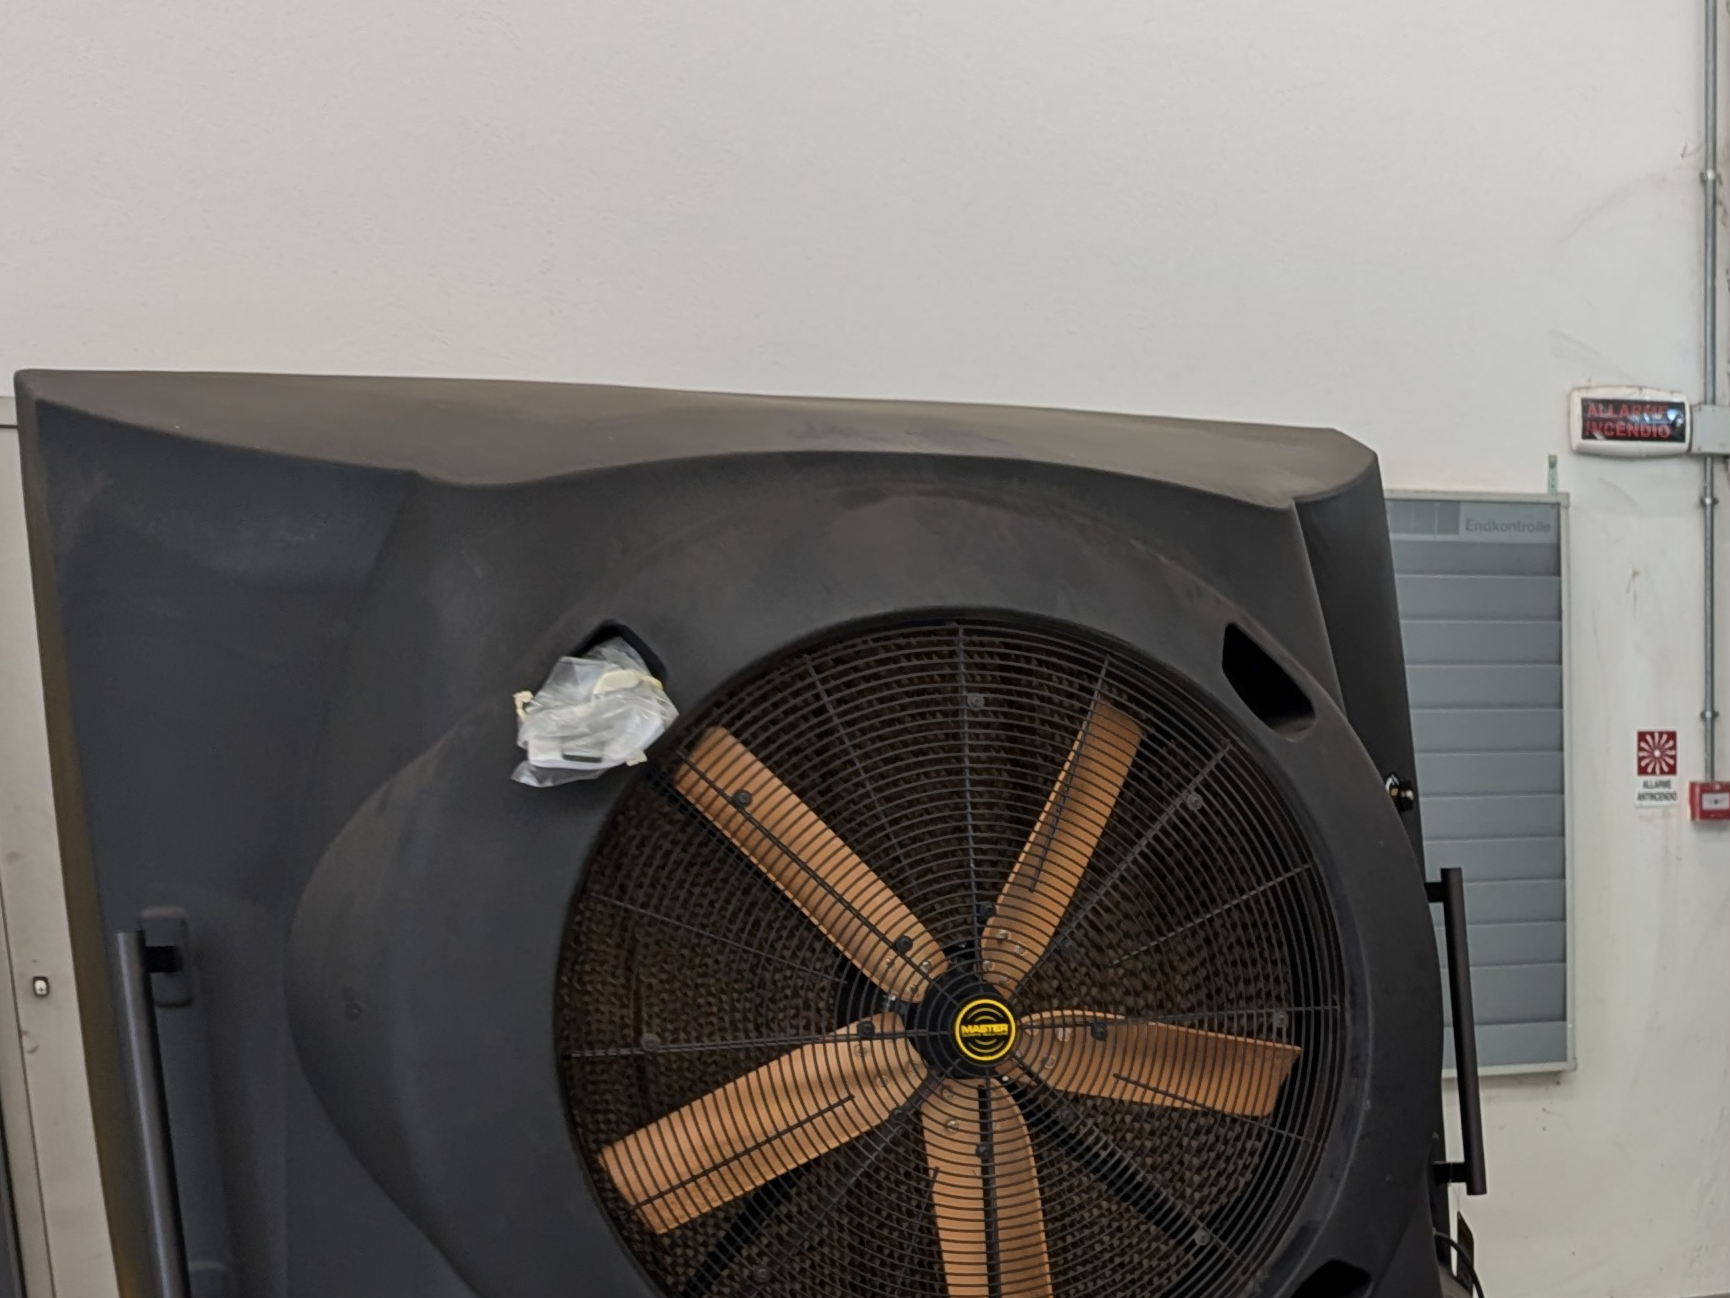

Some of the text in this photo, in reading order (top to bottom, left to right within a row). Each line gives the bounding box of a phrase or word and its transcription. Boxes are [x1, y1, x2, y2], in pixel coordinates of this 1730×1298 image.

[1585, 421, 1671, 438] INCENDIO
[1465, 517, 1551, 533] Endkontrolle
[1643, 779, 1671, 790] ALLARME
[961, 1024, 1009, 1033] MASTER
